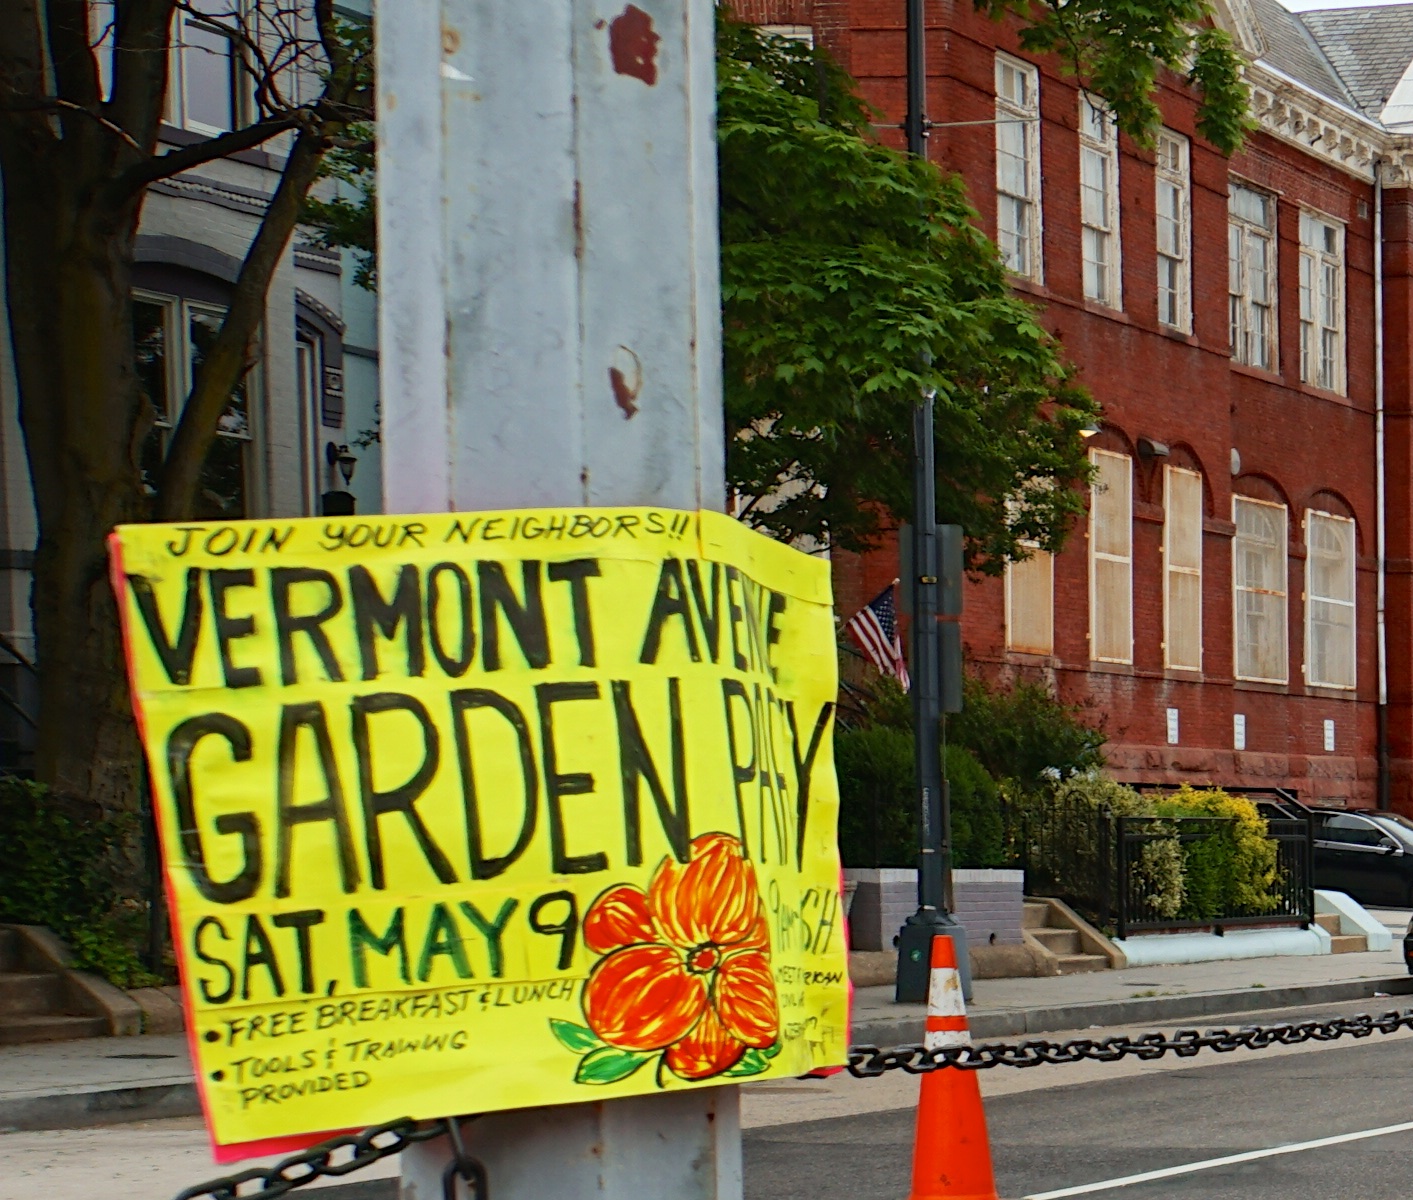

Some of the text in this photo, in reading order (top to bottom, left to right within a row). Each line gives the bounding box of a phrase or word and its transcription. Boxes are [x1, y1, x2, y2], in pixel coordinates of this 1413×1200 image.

[166, 511, 691, 558] JOIN YOUR NEIGHBORS!!
[126, 558, 601, 688] VERMONT
[166, 678, 692, 903] GARDEN
[195, 889, 578, 1005] SAT, MAY 9
[227, 1012, 307, 1047] FREE
[315, 988, 477, 1031] BREAKFAST
[495, 978, 575, 1008] LUNCH
[230, 1048, 316, 1084] TOOLS
[238, 1070, 373, 1110] PROVIDED
